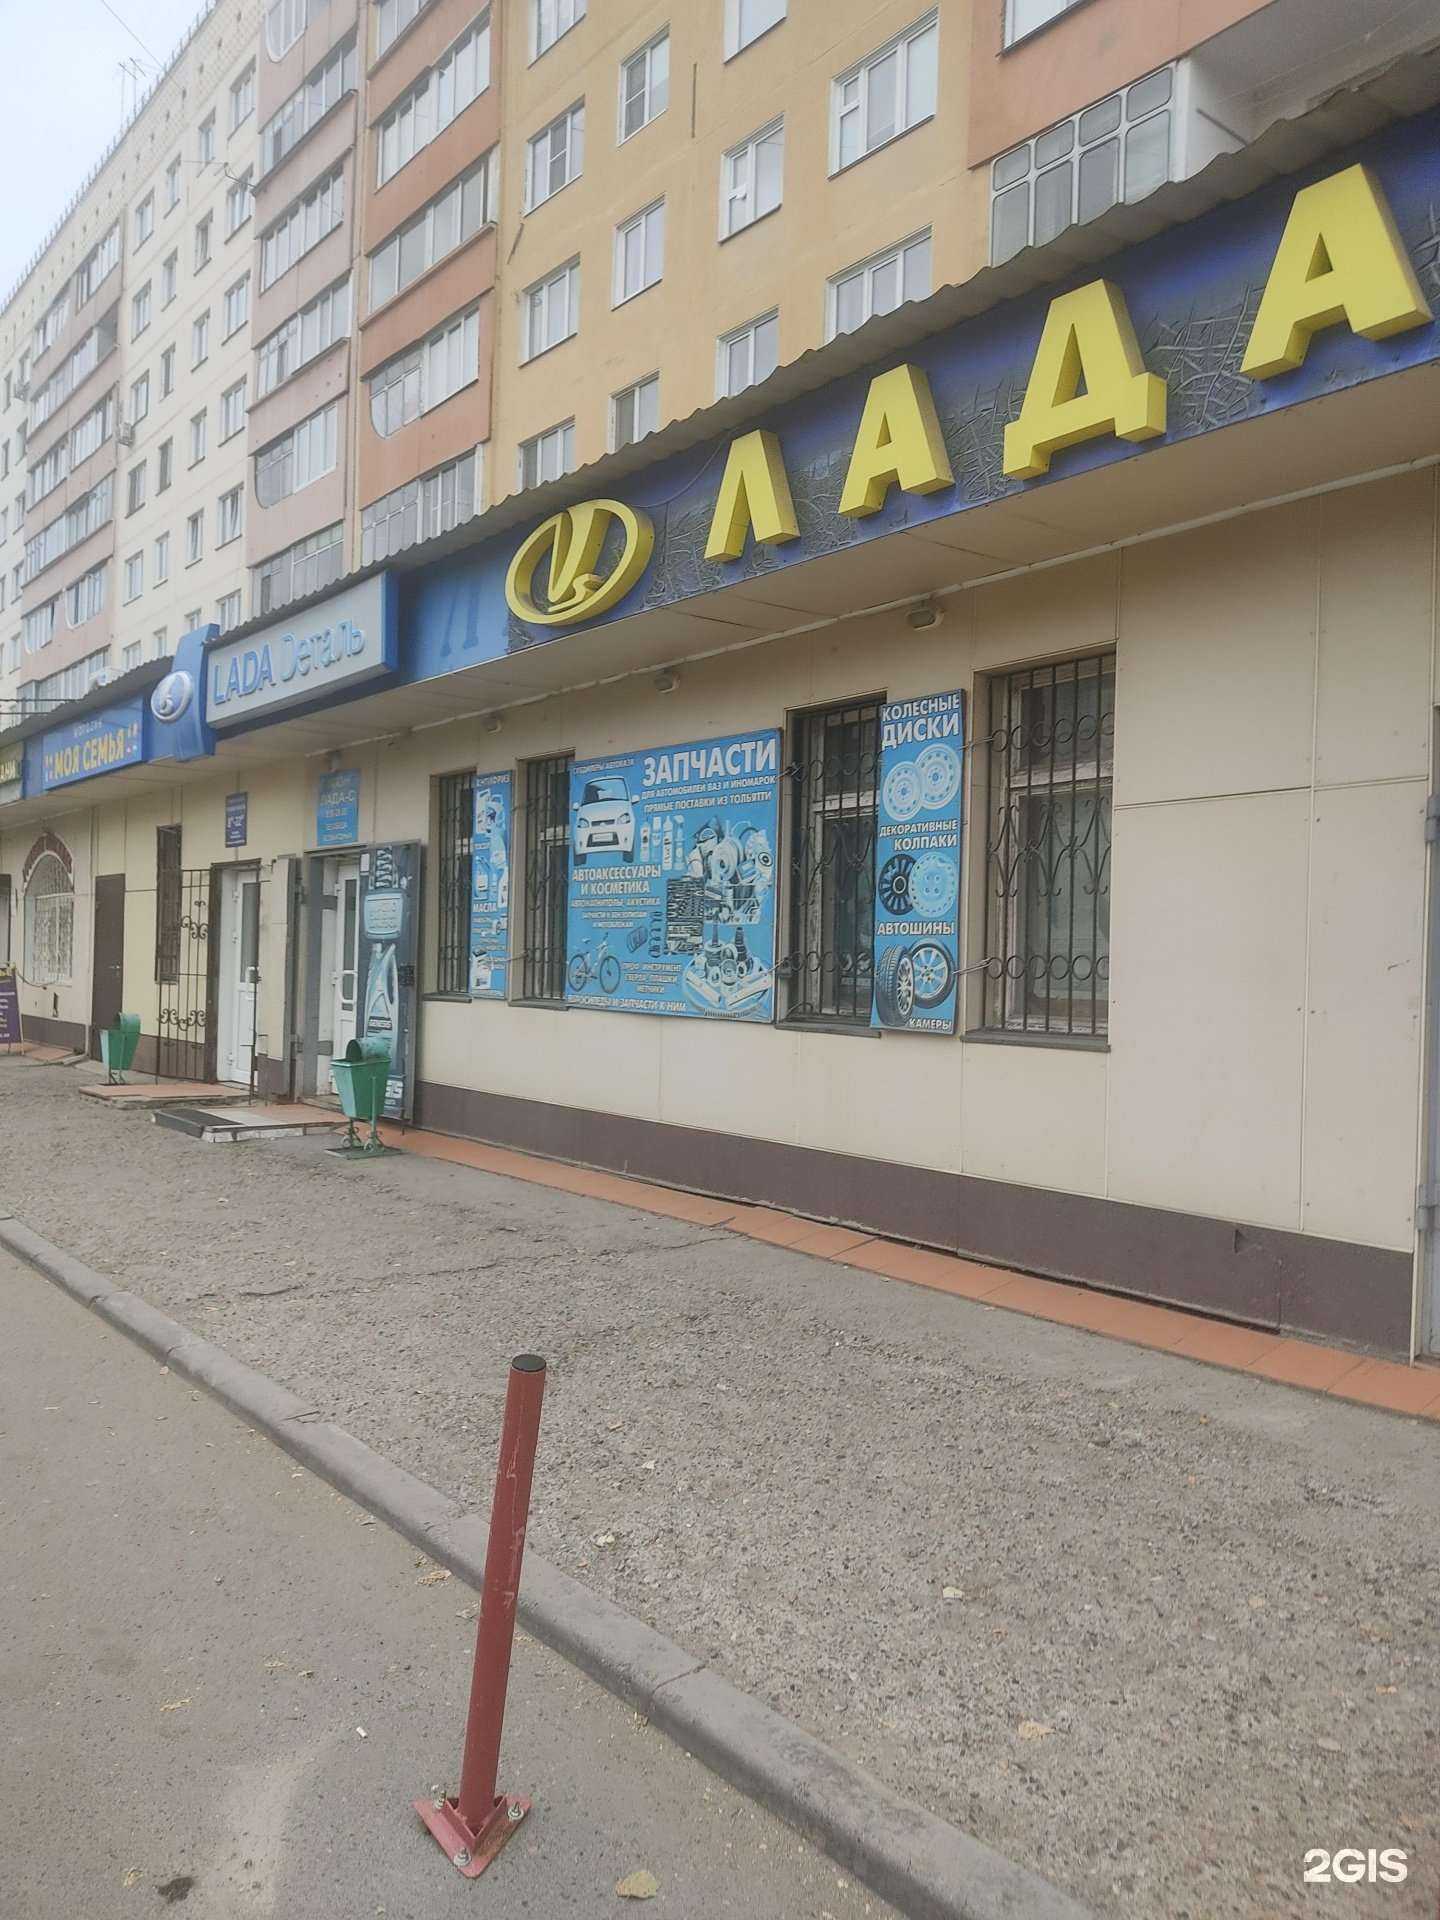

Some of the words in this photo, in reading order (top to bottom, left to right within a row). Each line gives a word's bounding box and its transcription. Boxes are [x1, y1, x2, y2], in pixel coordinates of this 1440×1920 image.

[703, 163, 1434, 563] ЛАДА
[214, 641, 276, 705] LADA
[882, 694, 960, 722] КОЛЕСНЫЕ
[882, 713, 959, 750] ДИСКИ
[83, 728, 125, 771] СЕМЬЯ
[642, 739, 777, 787] ЗАПЧАСТИ
[707, 782, 721, 792] ВАЗ
[723, 781, 729, 789] И
[731, 776, 777, 788] ИНОМАРОК
[644, 801, 674, 812] ПРЯМЫЕ
[675, 798, 714, 809] ПОСТАВКИ
[716, 796, 728, 806] ИЗ
[730, 791, 772, 803] ТОЛЬЯТТИ
[879, 819, 958, 837] ДЕКОРАТИВНЫЕ
[894, 834, 957, 850] КОЛПАКИ
[572, 865, 661, 881] АВТОАКСЕССУАРЫ
[581, 882, 588, 895] И
[591, 881, 650, 895] КОСМЕТИКА
[472, 903, 497, 913] МАСЛА
[877, 922, 954, 935] АВТОШИНЫ
[620, 998, 658, 1010] ЗАПЧАСТИ
[908, 1018, 951, 1030] КАМЕРЫ
